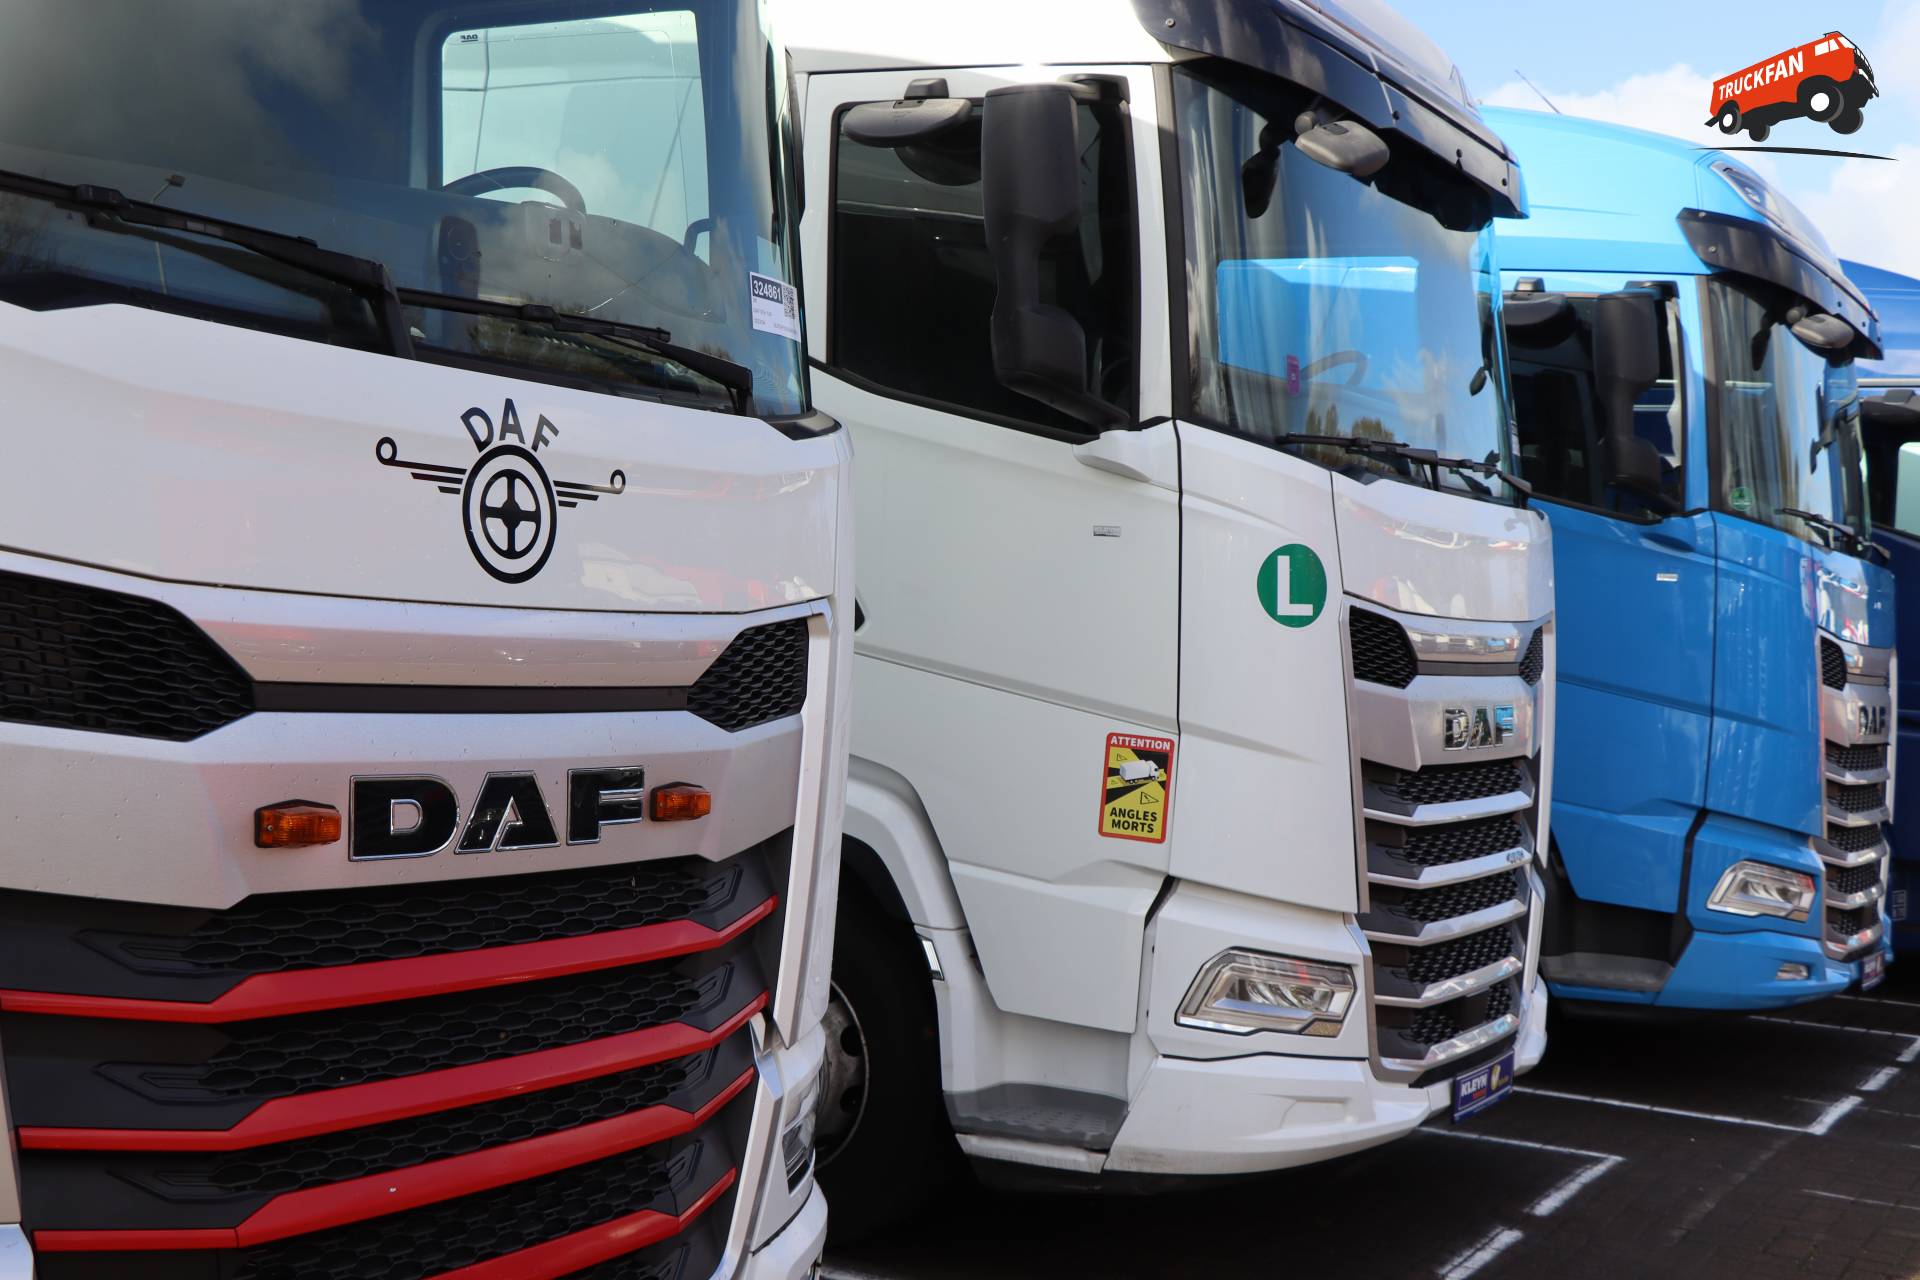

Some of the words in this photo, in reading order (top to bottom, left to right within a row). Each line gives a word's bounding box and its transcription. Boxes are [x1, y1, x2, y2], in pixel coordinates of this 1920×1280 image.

[753, 280, 782, 300] 324861
[460, 398, 560, 453] DAF
[1277, 555, 1313, 616] L
[1110, 735, 1171, 750] ATTENTION
[1443, 705, 1514, 751] DAF
[349, 766, 645, 861] DAF
[1110, 807, 1158, 822] ANGLES
[1111, 819, 1154, 833] MORTS
